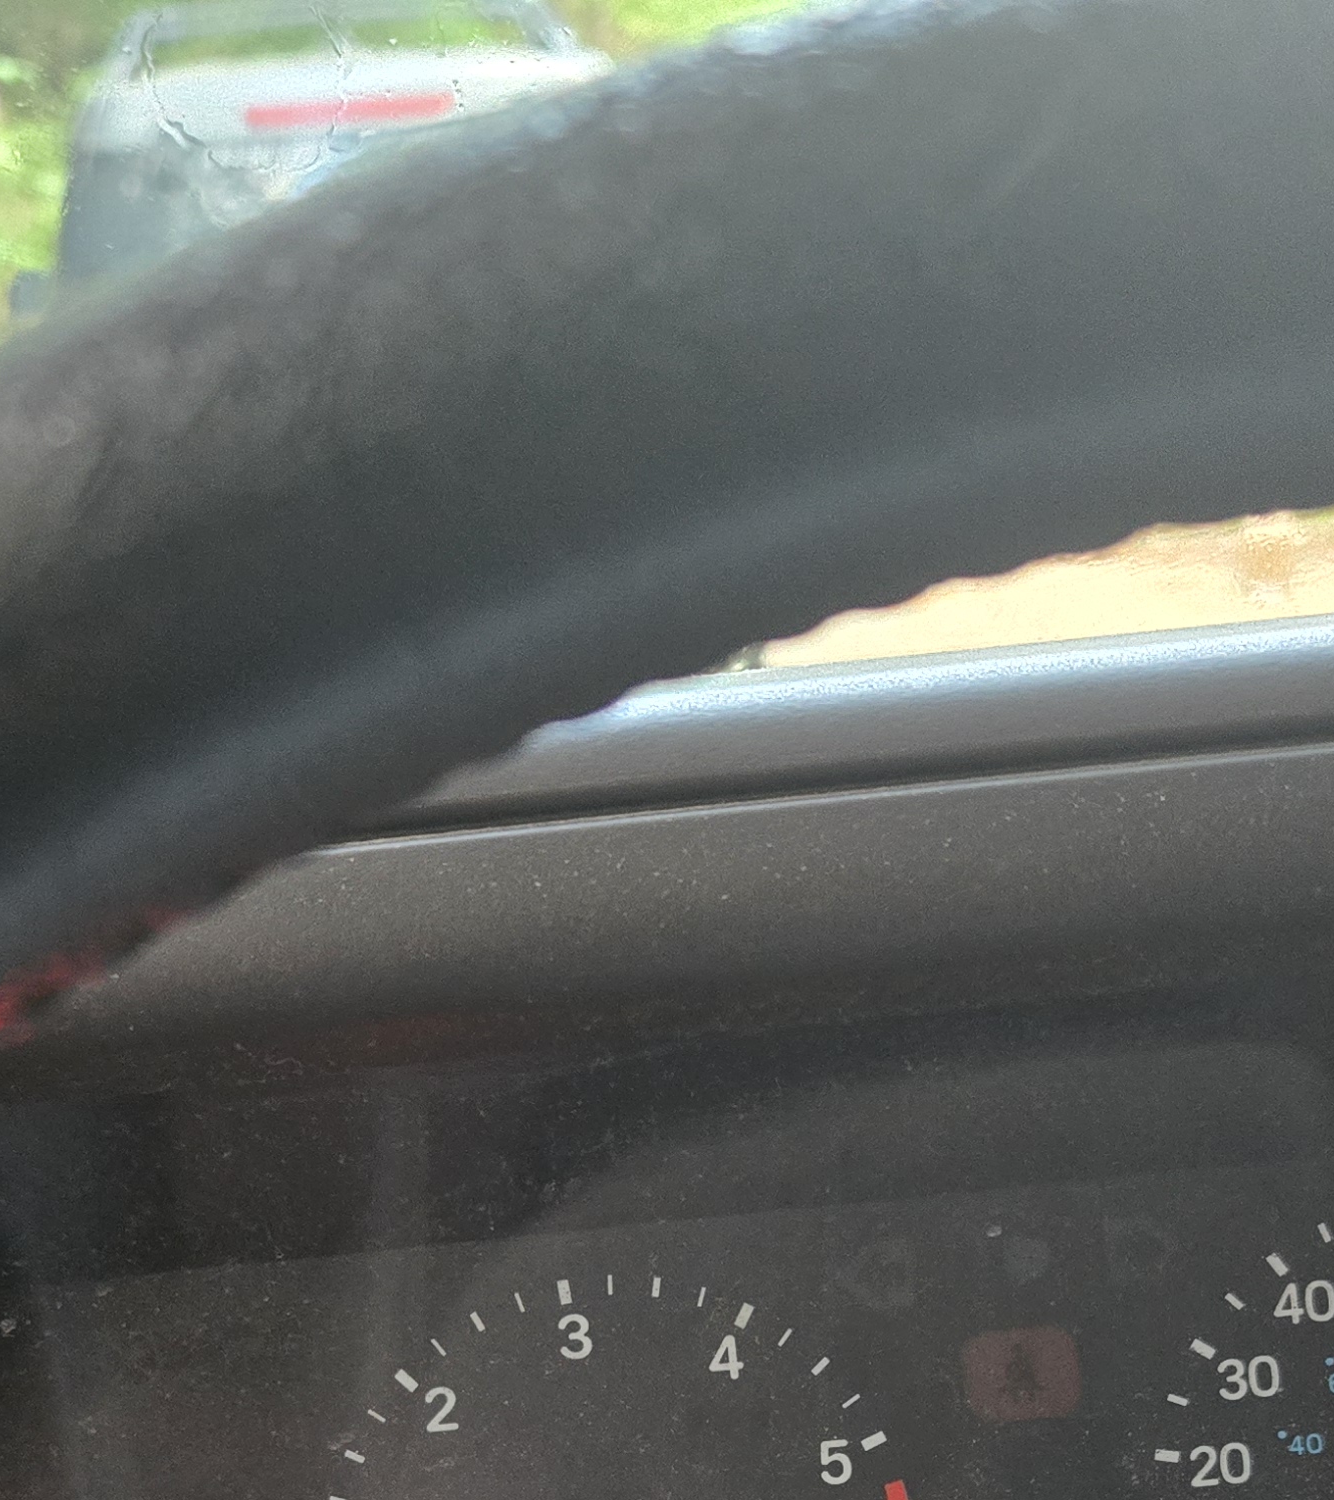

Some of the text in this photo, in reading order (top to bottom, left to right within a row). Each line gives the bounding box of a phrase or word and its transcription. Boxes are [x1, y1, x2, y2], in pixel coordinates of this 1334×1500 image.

[558, 1314, 593, 1360] 3
[708, 1335, 743, 1380] 4
[1217, 1355, 1280, 1401] 30
[424, 1386, 459, 1432] 2
[820, 1440, 852, 1484] 5
[1190, 1442, 1252, 1487] 20
[1288, 1433, 1323, 1455] 40
